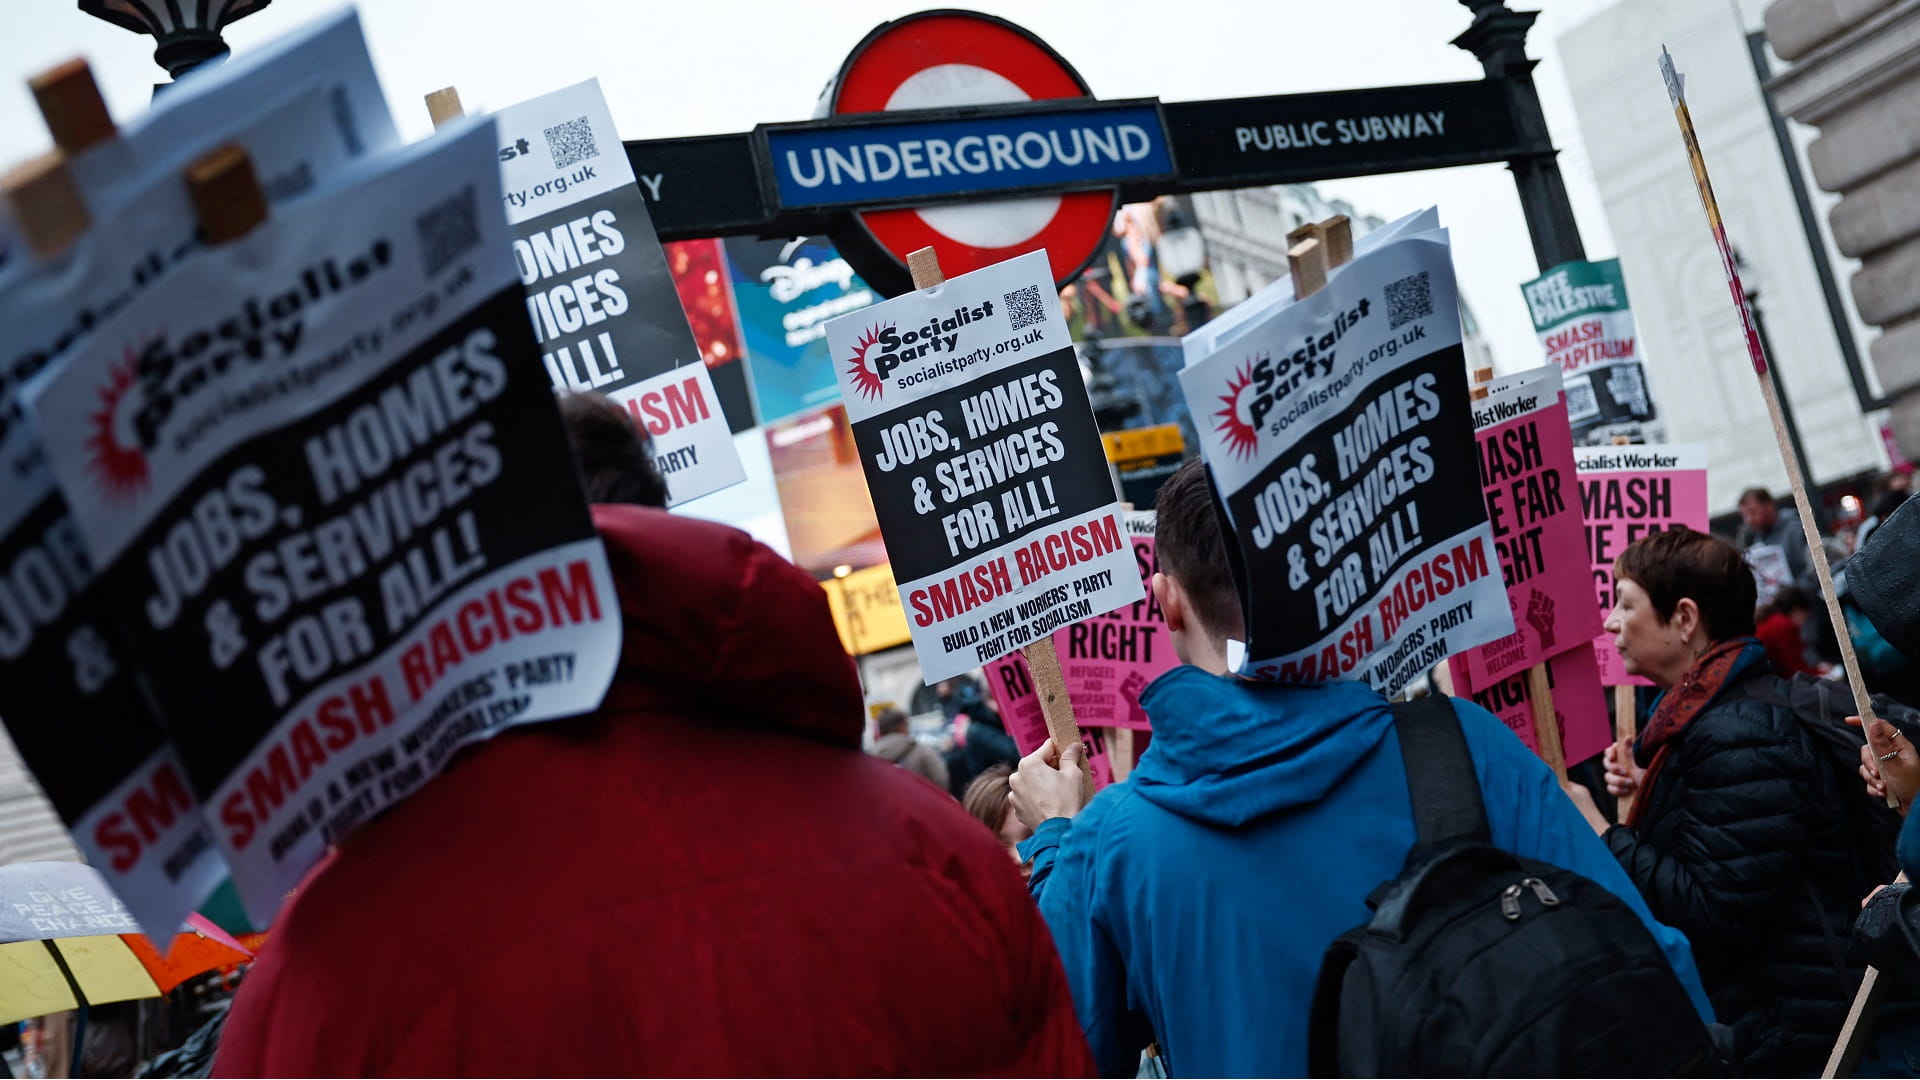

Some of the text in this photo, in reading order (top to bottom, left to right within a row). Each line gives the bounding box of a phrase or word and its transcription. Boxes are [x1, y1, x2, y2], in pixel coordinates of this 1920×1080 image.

[785, 124, 1151, 188] UNDERGROUND
[1236, 111, 1445, 152] PUBLIC SUBWAY
[512, 209, 625, 286] OMES
[135, 238, 392, 378] Socialist
[1525, 270, 1569, 304] FREE
[1531, 284, 1617, 327] PALESTINE
[874, 332, 959, 381] Party
[878, 300, 994, 354] Socialist
[897, 328, 1044, 389] socialistparty.org.uk
[1252, 297, 1370, 396] Socialist
[1546, 319, 1604, 355] SMASH
[133, 319, 303, 448] Party
[612, 376, 711, 441] ISM
[1249, 350, 1336, 431] Party
[1270, 324, 1426, 438] socialistparty.org.uk
[1494, 396, 1538, 420] Worker
[875, 409, 960, 472] JOBS,
[960, 369, 1063, 440] HOMES
[146, 328, 507, 629] JOBS, HOMES
[911, 421, 1065, 515] & SERVICES
[1251, 371, 1440, 549] JOBS, HOMES
[1577, 453, 1678, 471] cialist Worker
[942, 475, 1060, 558] FOR ALL!
[1286, 543, 1310, 591] &
[1309, 435, 1435, 569] SERVICES
[1511, 468, 1566, 528] FAR
[1578, 478, 1672, 520] MASH
[204, 421, 502, 669] & SERVICES
[909, 556, 1013, 628] SMASH
[1014, 514, 1123, 586] RACISM
[1313, 551, 1367, 632] FOR
[1368, 500, 1423, 584] ALL!
[1495, 526, 1545, 589] GHT
[256, 510, 487, 708] FOR ALL!
[942, 625, 979, 653] BUILD
[981, 621, 990, 639] A
[989, 608, 1015, 634] NEW
[1073, 569, 1113, 597] PARTY
[975, 599, 1092, 663] FIGHT FOR SOCIALISM
[1254, 614, 1373, 682] SMASH
[1378, 535, 1490, 642] RACISM
[1430, 600, 1474, 638] PARTY
[504, 651, 577, 689] PARTY
[1069, 621, 1157, 663] RIGHT
[1070, 665, 1115, 679] REFUGEES
[1389, 637, 1448, 697] SOCIALISM
[1486, 645, 1527, 677] WELCOME
[220, 674, 395, 850] SMASH
[398, 560, 602, 703] RACISM
[14, 901, 106, 917] PEACE
[29, 912, 138, 931] CHANCE
